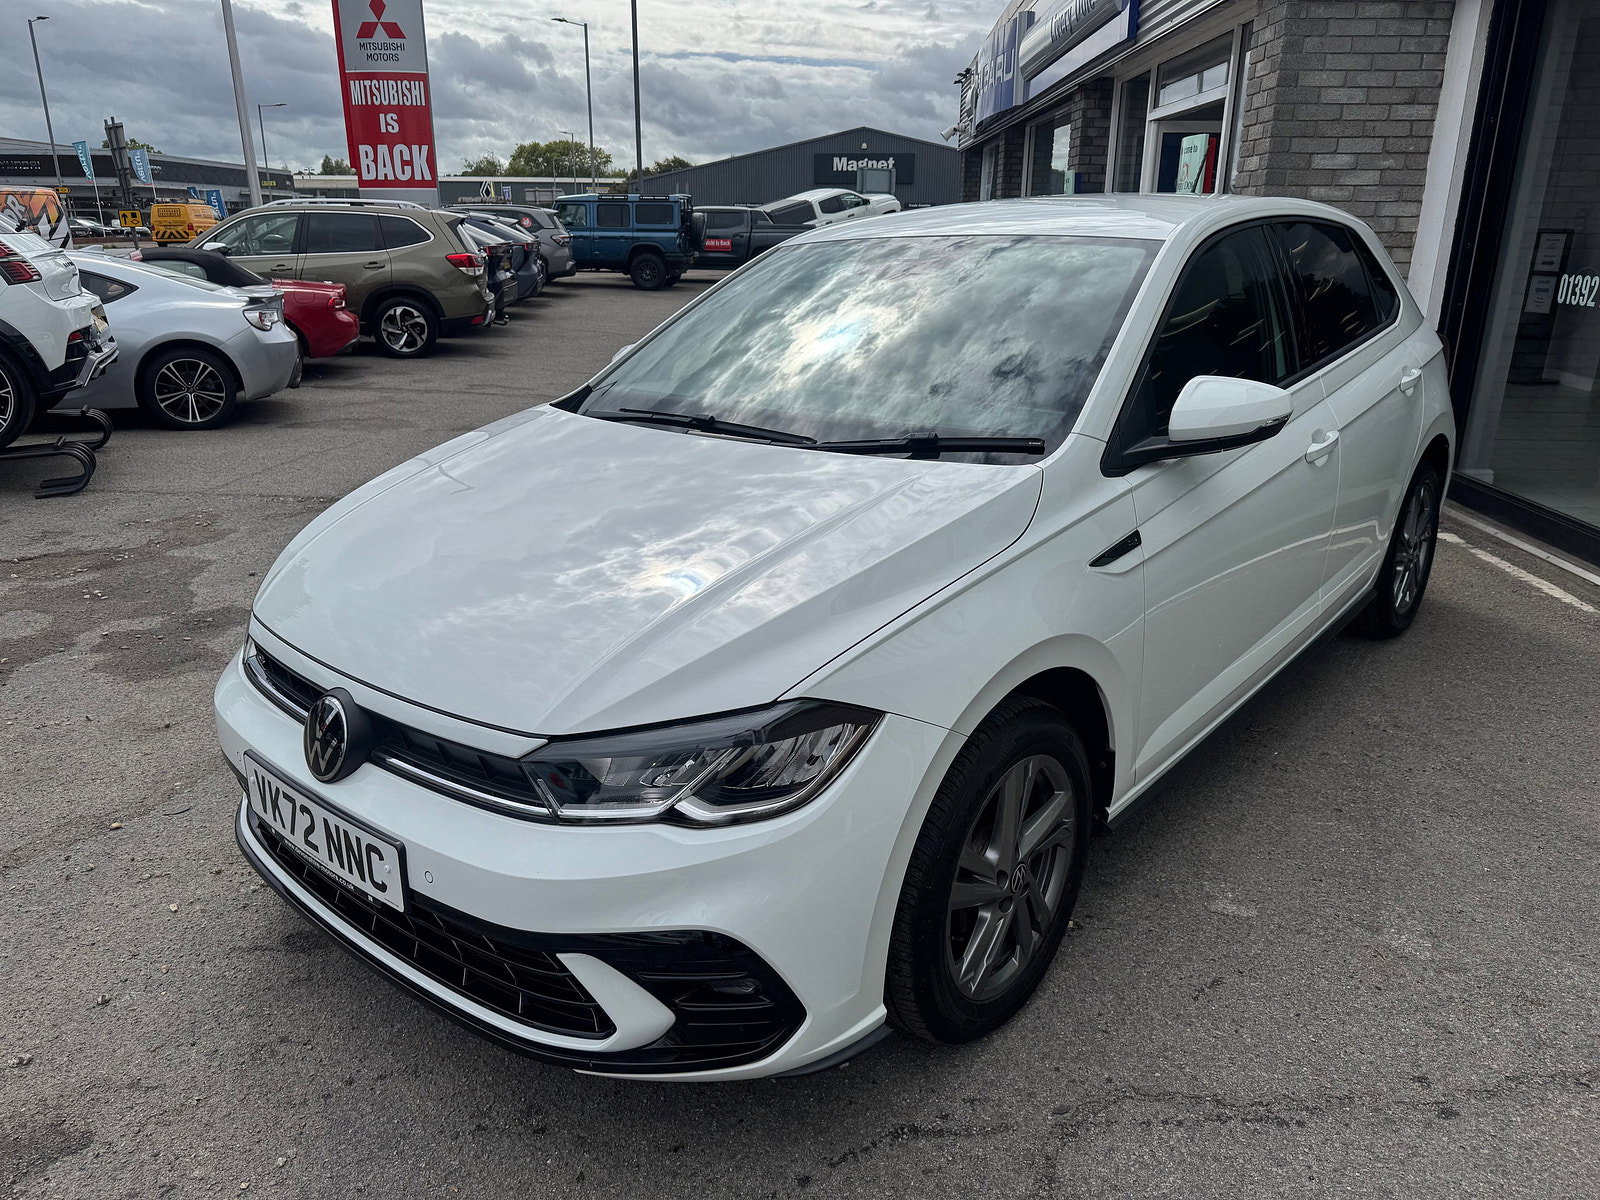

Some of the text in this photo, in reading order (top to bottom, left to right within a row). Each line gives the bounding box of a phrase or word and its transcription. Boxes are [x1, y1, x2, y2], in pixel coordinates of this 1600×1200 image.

[1050, 6, 1073, 43] Livery
[359, 42, 405, 51] MITSUBISHI
[367, 53, 399, 61] MOTORS
[350, 80, 425, 106] MITSUBISHI
[379, 113, 399, 133] IS
[358, 144, 432, 181] BACK
[833, 157, 895, 171] Magnet
[1558, 273, 1599, 307] 01392
[253, 769, 320, 853] VK72
[322, 817, 388, 893] NNC
